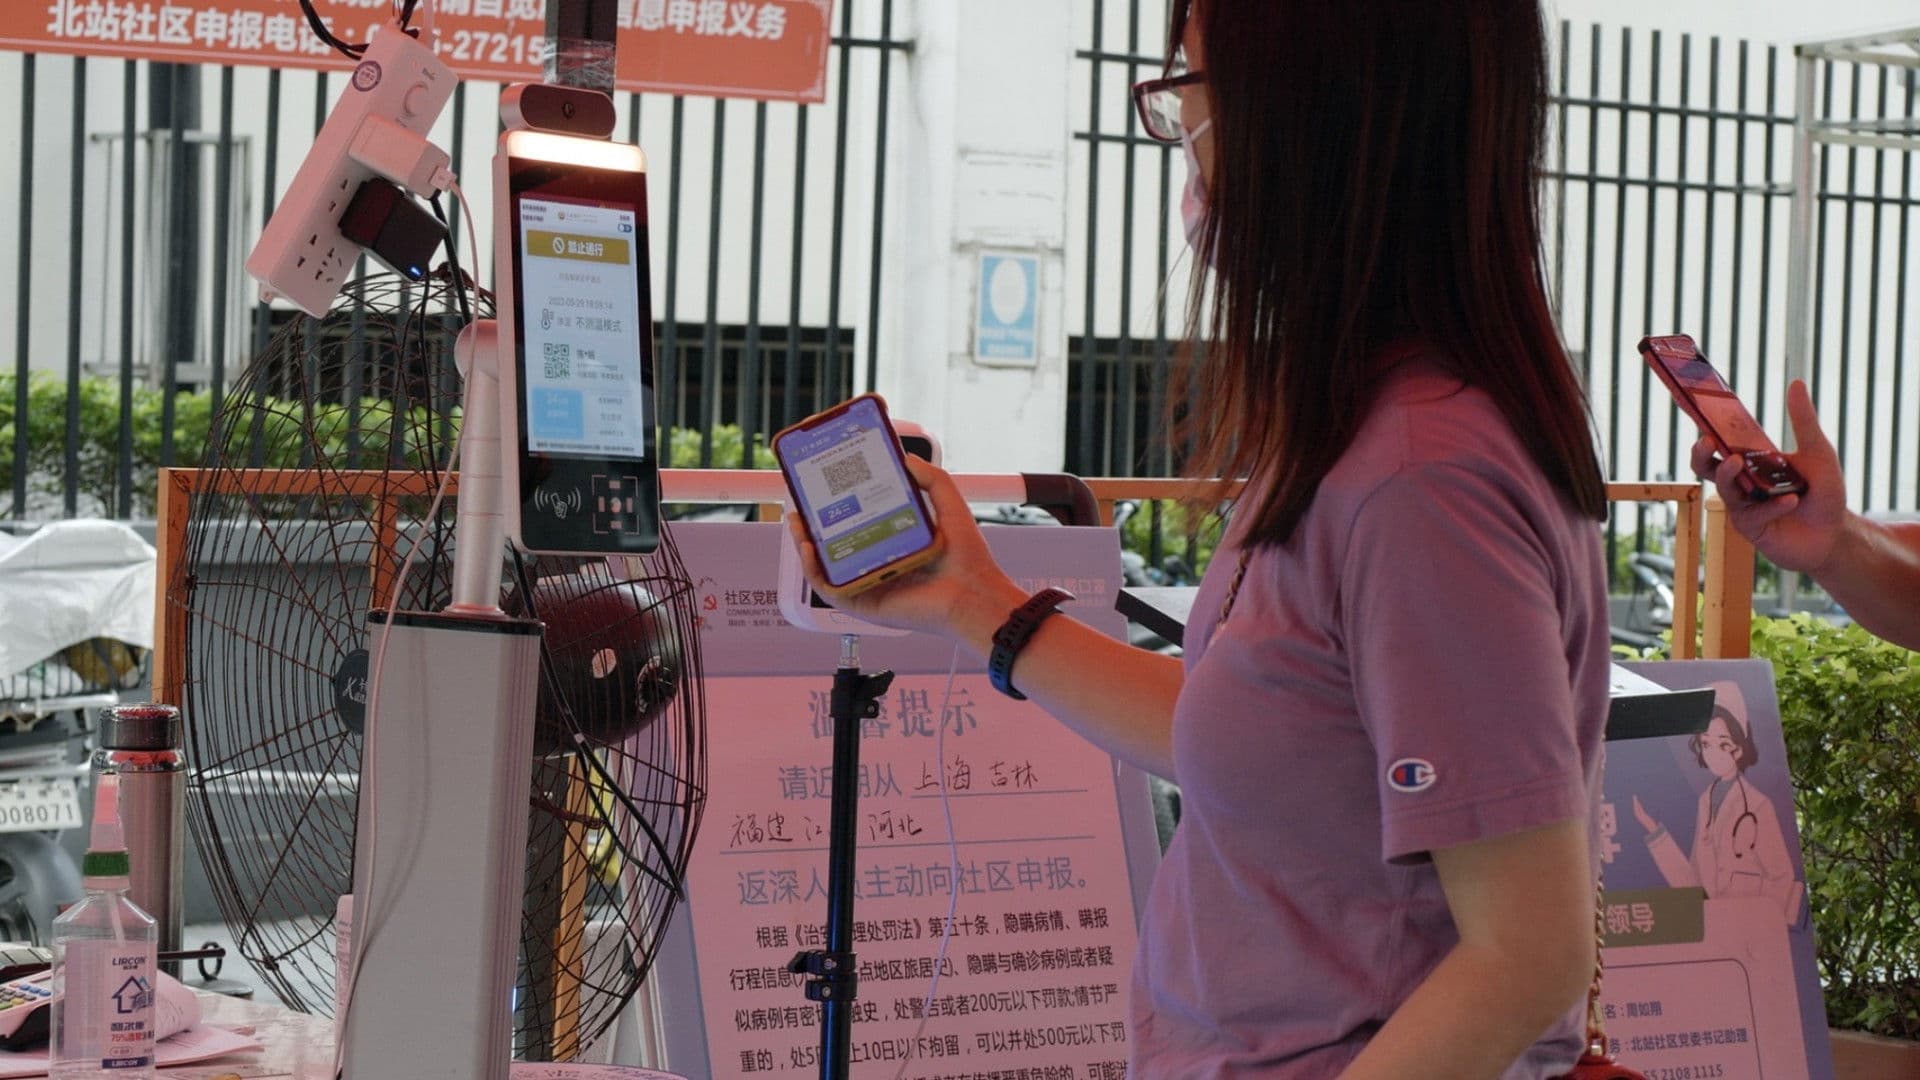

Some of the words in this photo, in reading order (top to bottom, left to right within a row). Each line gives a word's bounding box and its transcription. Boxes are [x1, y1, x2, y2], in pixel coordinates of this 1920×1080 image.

[737, 855, 1087, 906] 返深人主动向社区申报。
[1606, 902, 1655, 934] 领导
[112, 956, 147, 967] LIRCON
